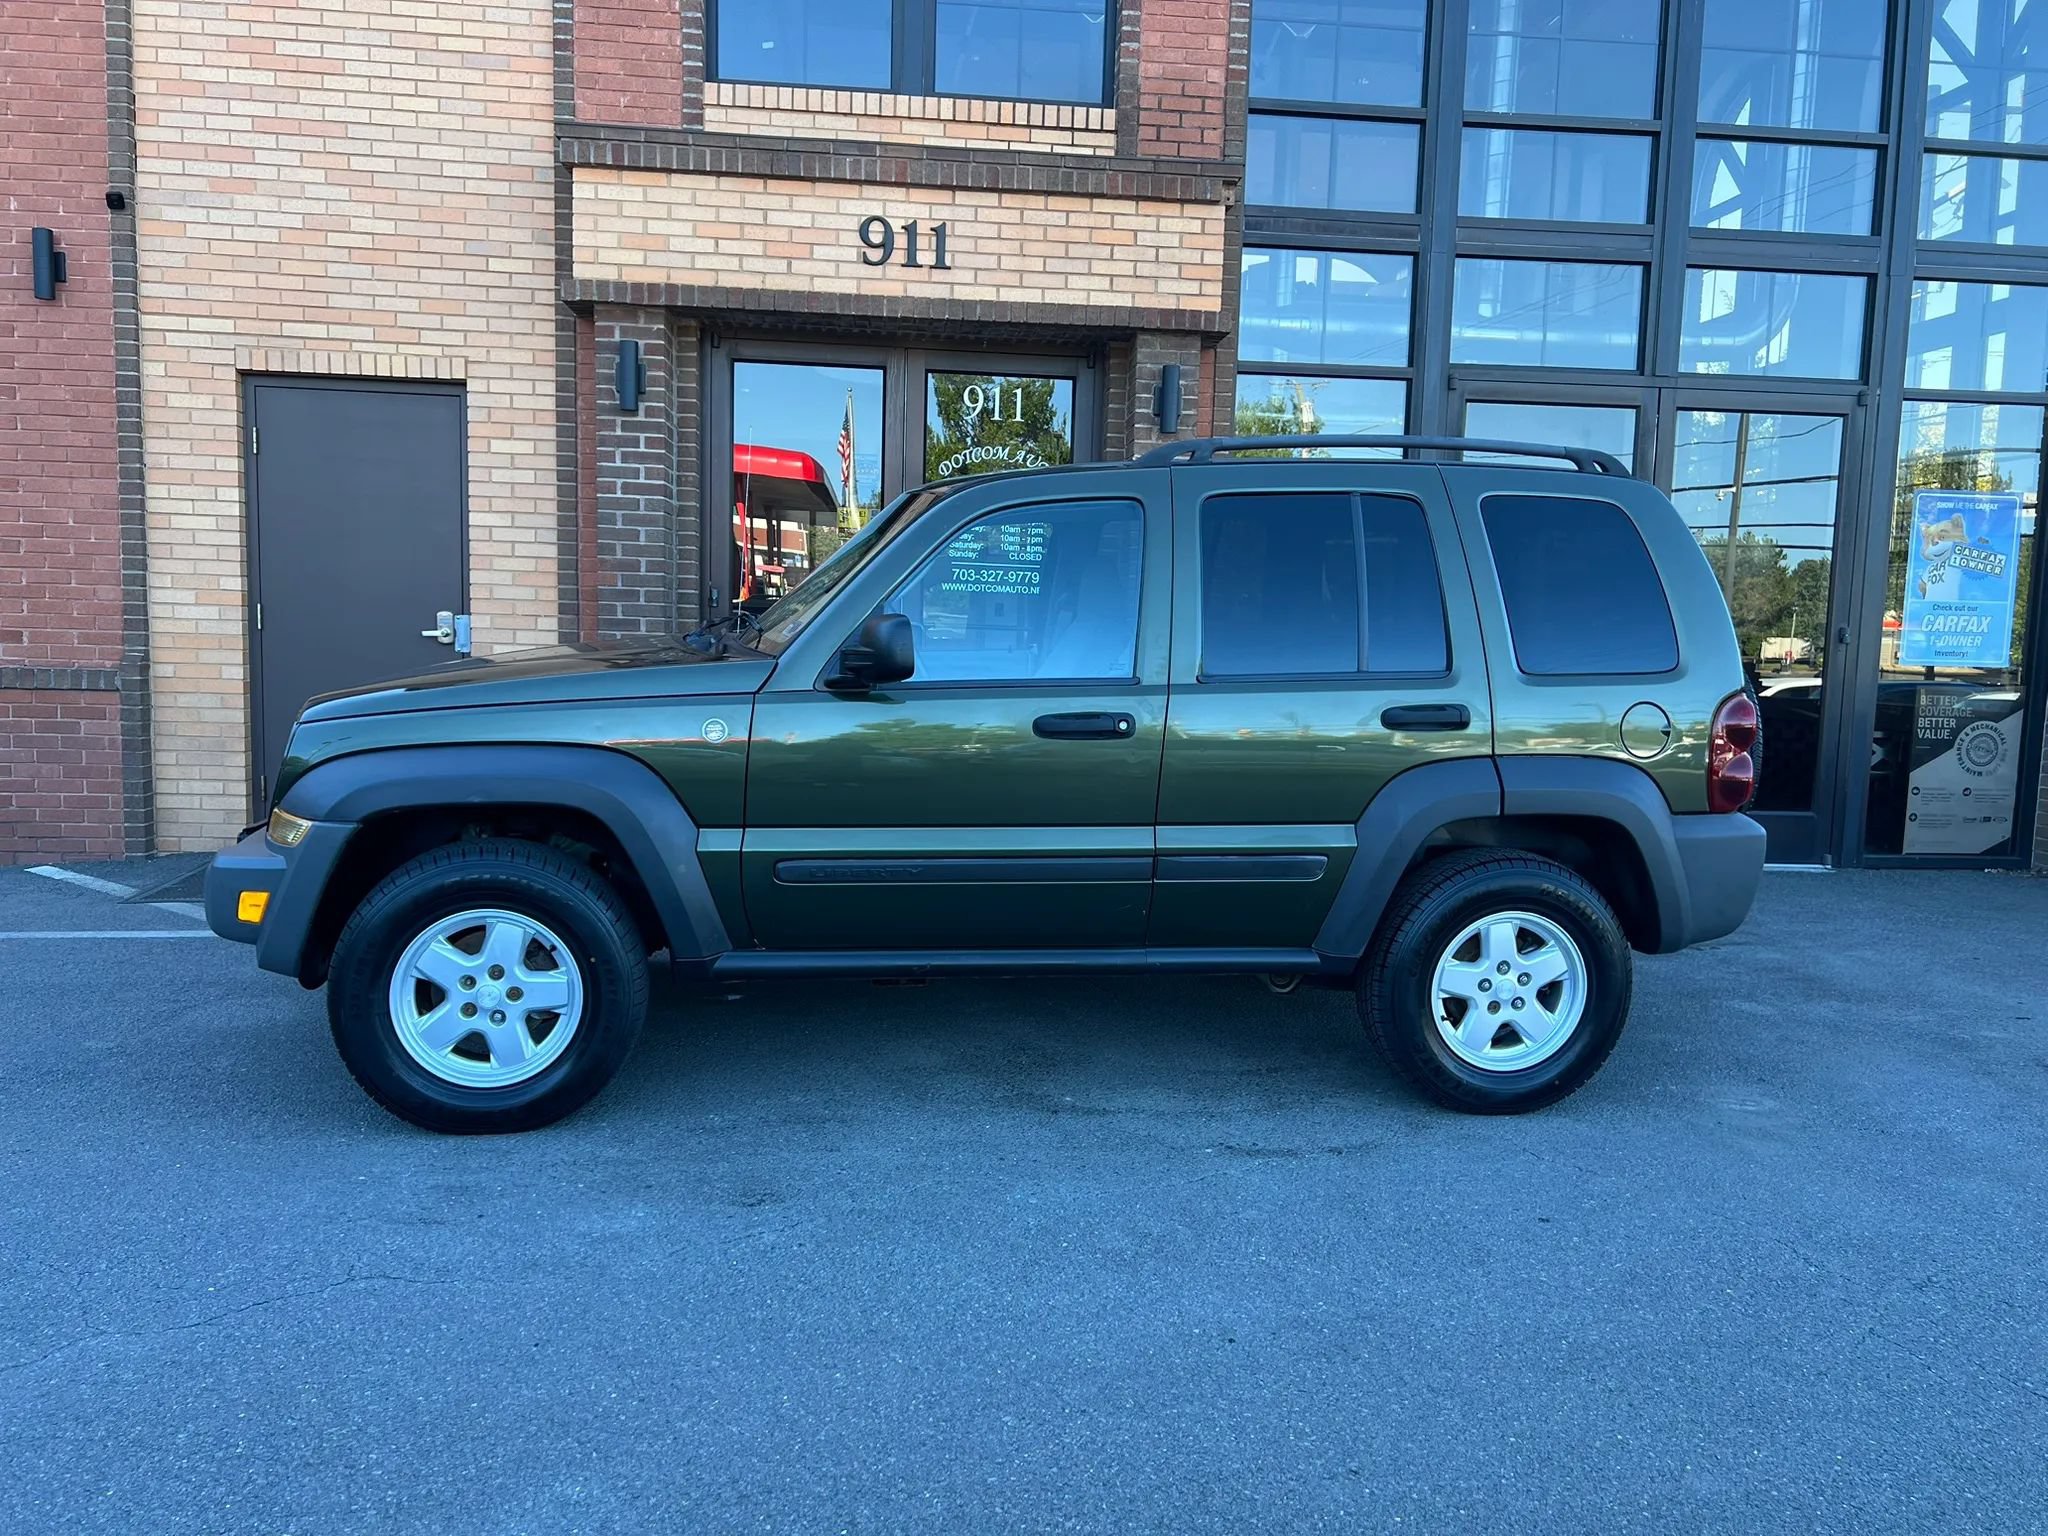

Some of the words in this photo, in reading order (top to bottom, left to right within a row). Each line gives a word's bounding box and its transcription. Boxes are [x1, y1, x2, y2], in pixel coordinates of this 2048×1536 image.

[859, 215, 951, 270] 911
[963, 385, 1025, 422] 911
[938, 446, 1010, 477] DOTCOM
[1000, 525, 1020, 533] 10am
[1000, 534, 1020, 542] 10am
[949, 540, 984, 550] Saturday:
[1000, 543, 1020, 551] 10am
[948, 549, 979, 560] Sunday:
[1009, 552, 1042, 561] CLOSED
[1954, 545, 2005, 565] CARFAX
[1928, 561, 1947, 574] CAR
[1960, 557, 2002, 575] OWNER
[951, 568, 1040, 584] 703-327-9779
[1933, 603, 1954, 612] Check
[1921, 614, 1992, 633] CARFAX
[1929, 634, 1983, 647] 1-OWNER
[1934, 649, 1968, 658] Inventory!
[1920, 694, 1958, 706] BETTER
[1919, 706, 1975, 718] COVERAGE.
[1918, 717, 1956, 729] BETTER
[1917, 729, 1952, 740] VALUE.
